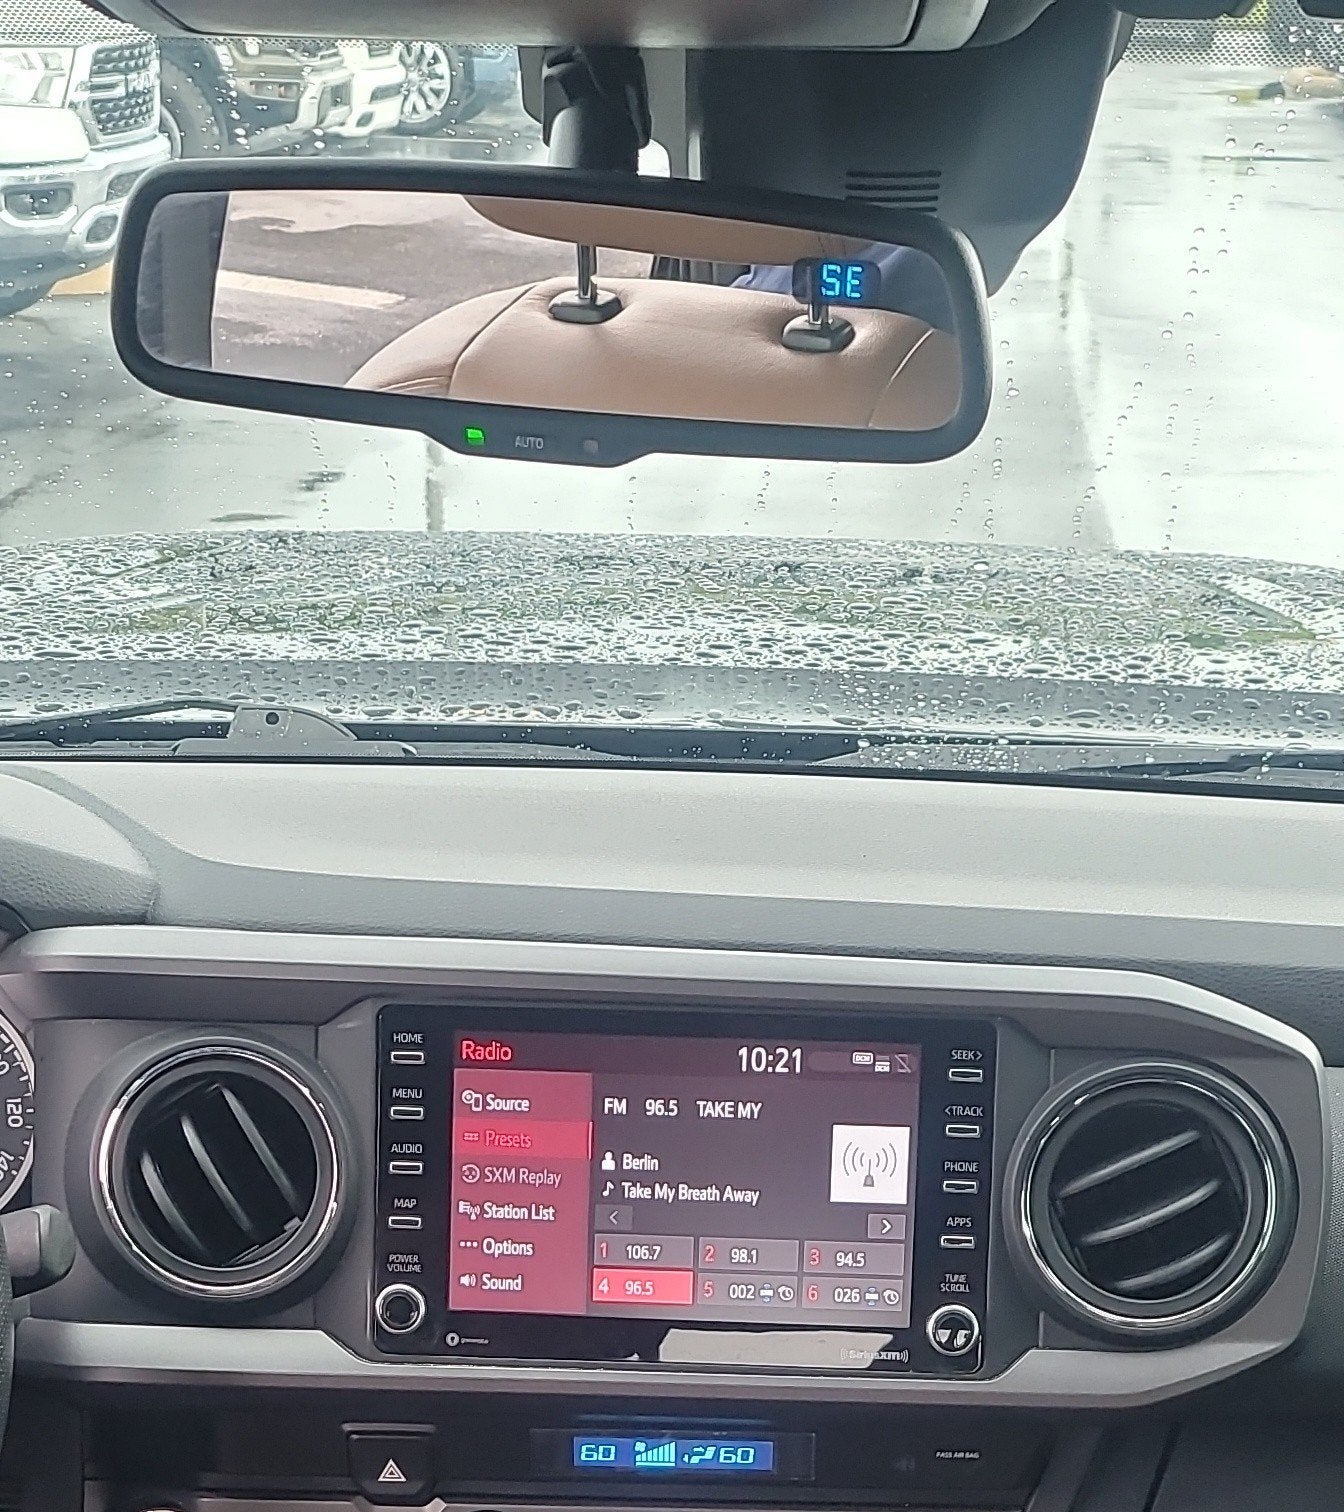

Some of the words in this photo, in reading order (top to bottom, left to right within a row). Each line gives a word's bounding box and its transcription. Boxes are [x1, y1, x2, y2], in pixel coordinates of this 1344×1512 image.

[820, 264, 863, 298] SE
[514, 434, 545, 449] AUTO
[392, 1032, 424, 1044] HOME
[460, 1039, 513, 1062] Radio
[737, 1046, 802, 1075] 10:21
[392, 1087, 424, 1099] MENU
[485, 1093, 530, 1113] Source
[5, 1097, 24, 1129] 120
[603, 1097, 628, 1116] FM
[644, 1099, 679, 1117] 96.5
[696, 1100, 735, 1119] TAKE
[737, 1101, 763, 1120] MY
[389, 1142, 424, 1155] AUDIO
[484, 1129, 533, 1150] Presets
[621, 1152, 660, 1172] Berlin
[943, 1161, 980, 1173] PHONE
[484, 1166, 517, 1184] SXM
[518, 1167, 563, 1189] Replay
[393, 1198, 418, 1209] MAP
[620, 1181, 652, 1200] Take
[654, 1182, 676, 1204] My
[677, 1183, 721, 1203] Breath
[722, 1185, 760, 1206] Away
[482, 1201, 529, 1221] Station
[530, 1203, 556, 1222] List
[946, 1216, 973, 1228] APPS
[482, 1237, 534, 1259] Options
[599, 1242, 609, 1259] 1
[625, 1244, 662, 1262] 106.7
[703, 1245, 716, 1263] 2
[730, 1247, 759, 1265] 98.1
[808, 1248, 821, 1266] 3
[835, 1251, 866, 1268] 94.5
[386, 1263, 423, 1274] VOLUME
[388, 1253, 420, 1264] POWER
[481, 1273, 522, 1292] Sound
[597, 1277, 610, 1295] 4
[624, 1279, 655, 1297] 96.5
[940, 1283, 970, 1293] SCROLL
[945, 1273, 968, 1284] TUNE
[703, 1280, 715, 1298] 5
[728, 1283, 756, 1301] 002
[807, 1284, 819, 1302] 6
[833, 1286, 861, 1305] 026
[579, 1444, 616, 1462] 60
[718, 1446, 756, 1465] 60
